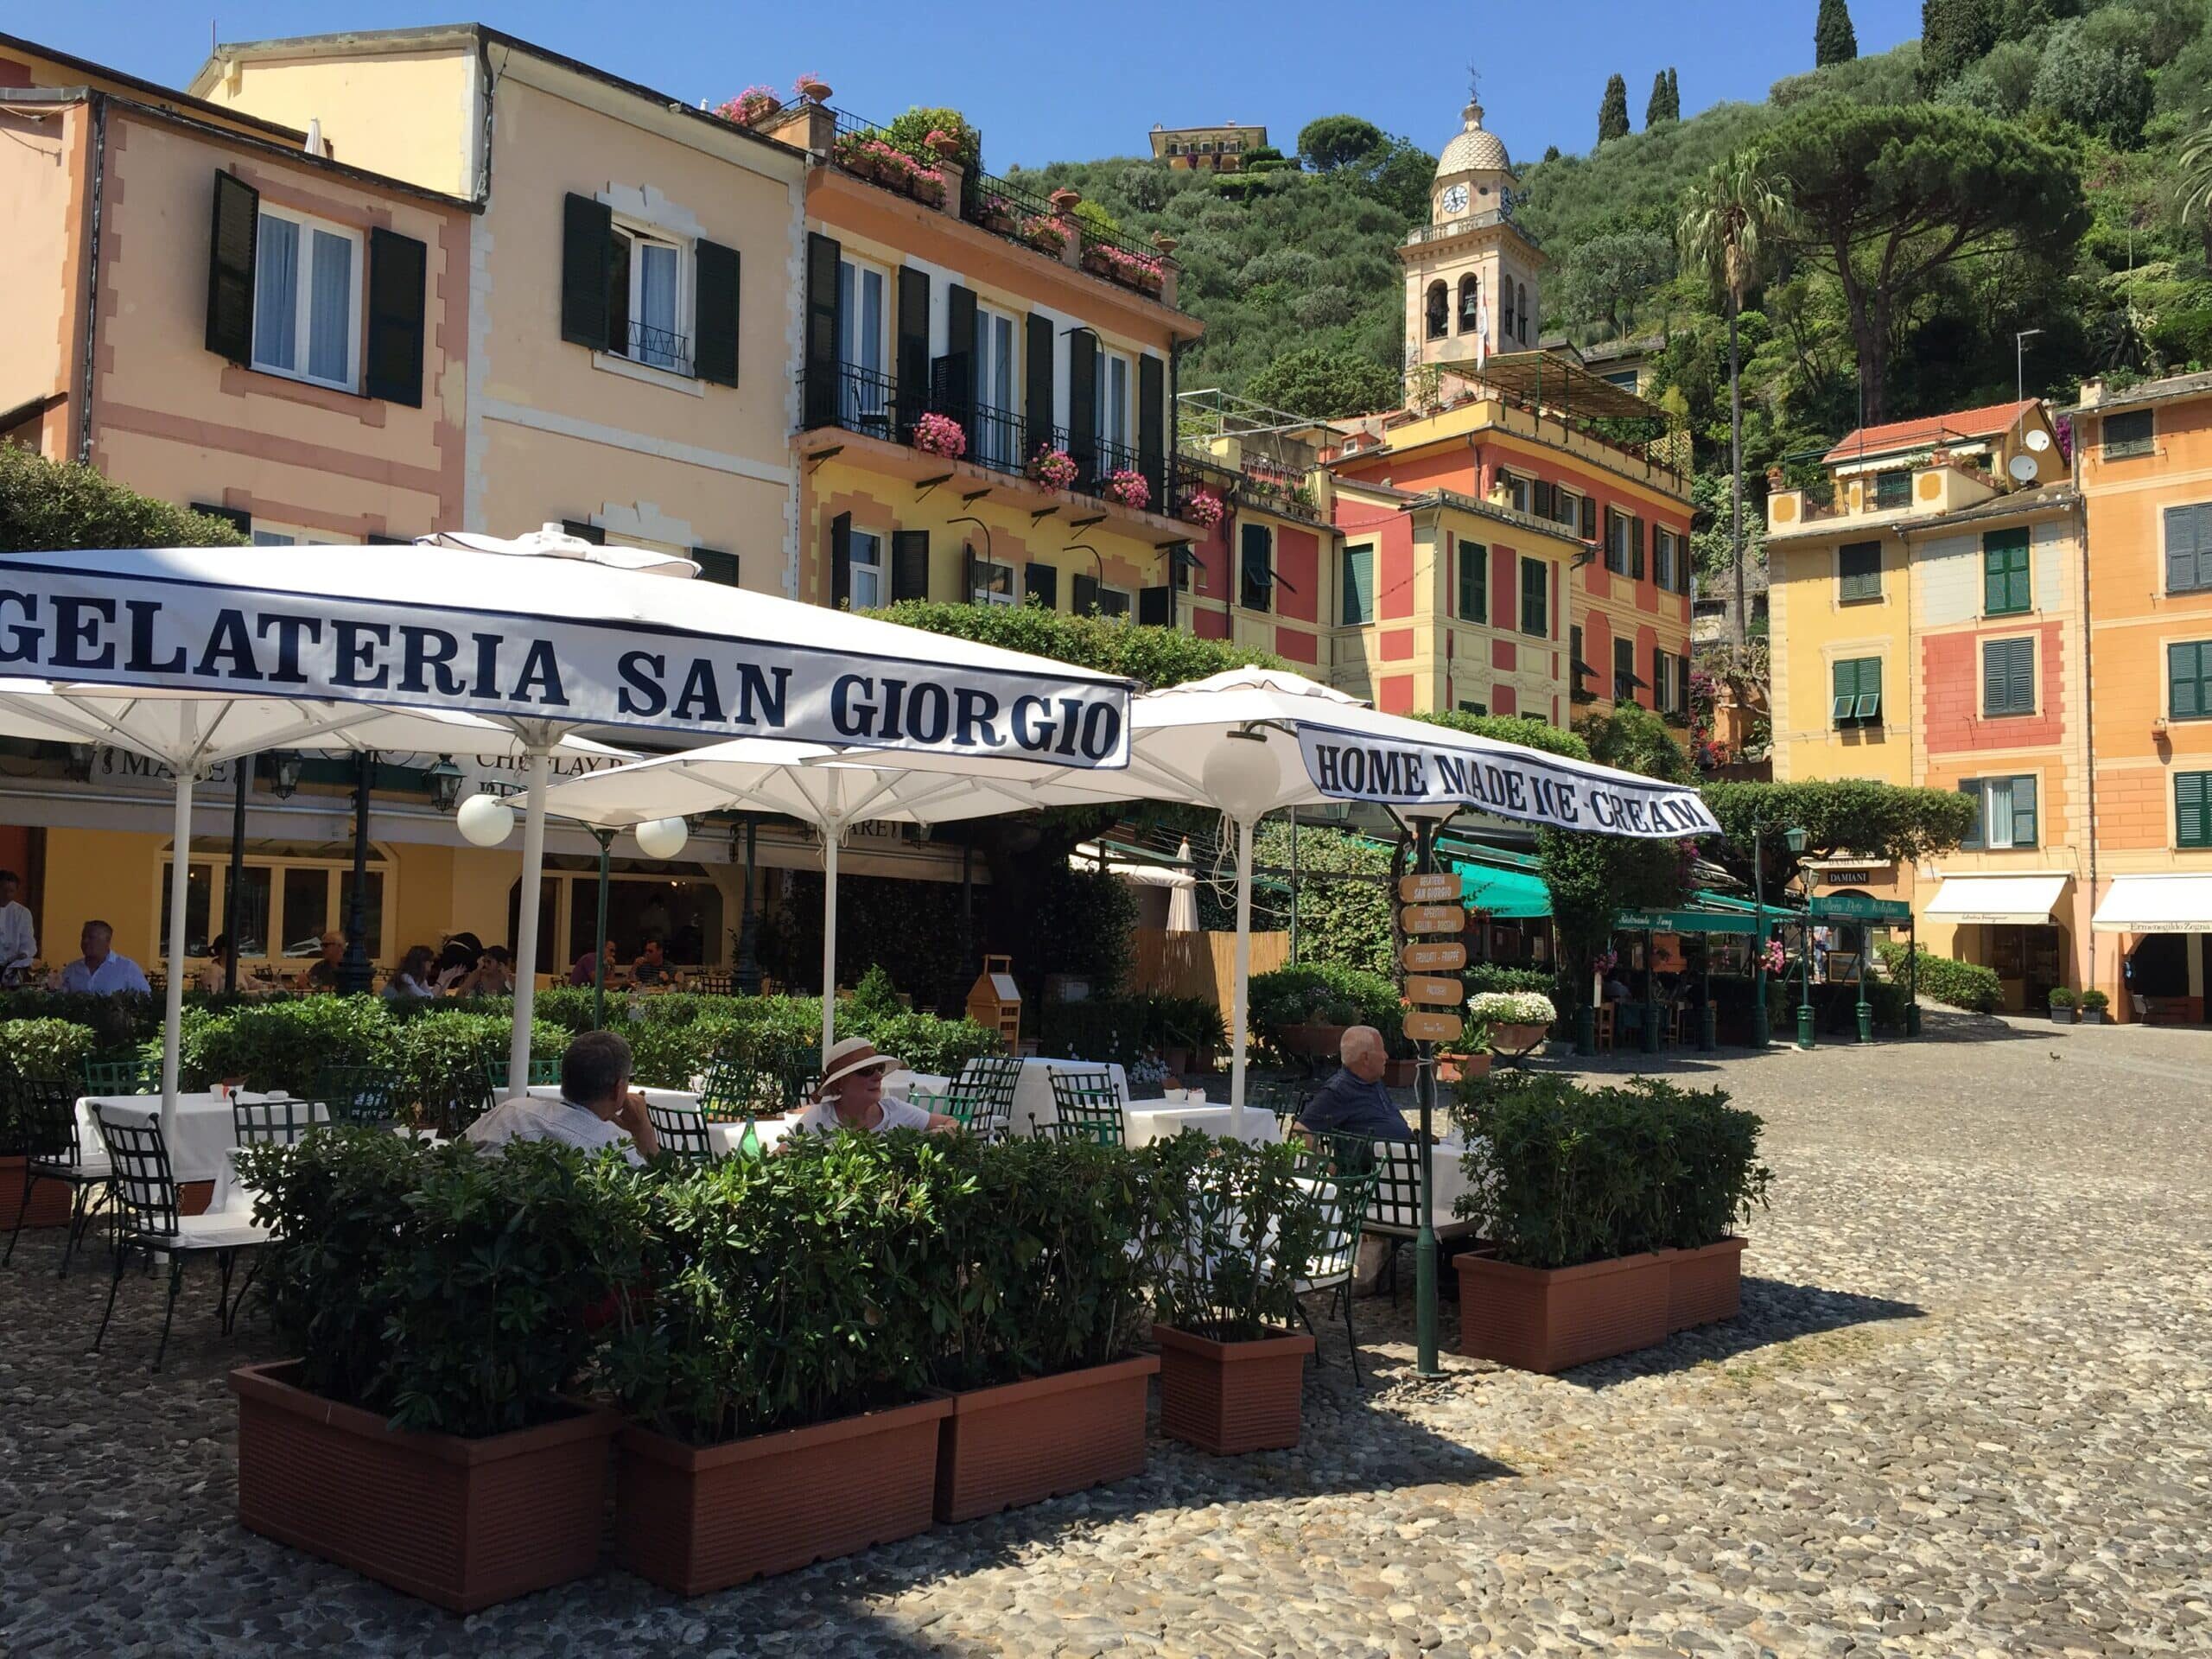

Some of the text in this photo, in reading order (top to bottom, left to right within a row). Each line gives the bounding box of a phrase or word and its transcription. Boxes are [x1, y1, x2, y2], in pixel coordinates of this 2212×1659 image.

[0, 589, 1120, 760] GELATERIA SAN GIORGIO
[120, 750, 227, 782] MAE
[476, 754, 601, 775] CHLAY
[1316, 744, 1429, 796] HOME
[1434, 754, 1527, 812] MADE
[1830, 873, 1866, 882] DAMIANI
[1414, 887, 1452, 899] SAN GIORGIO
